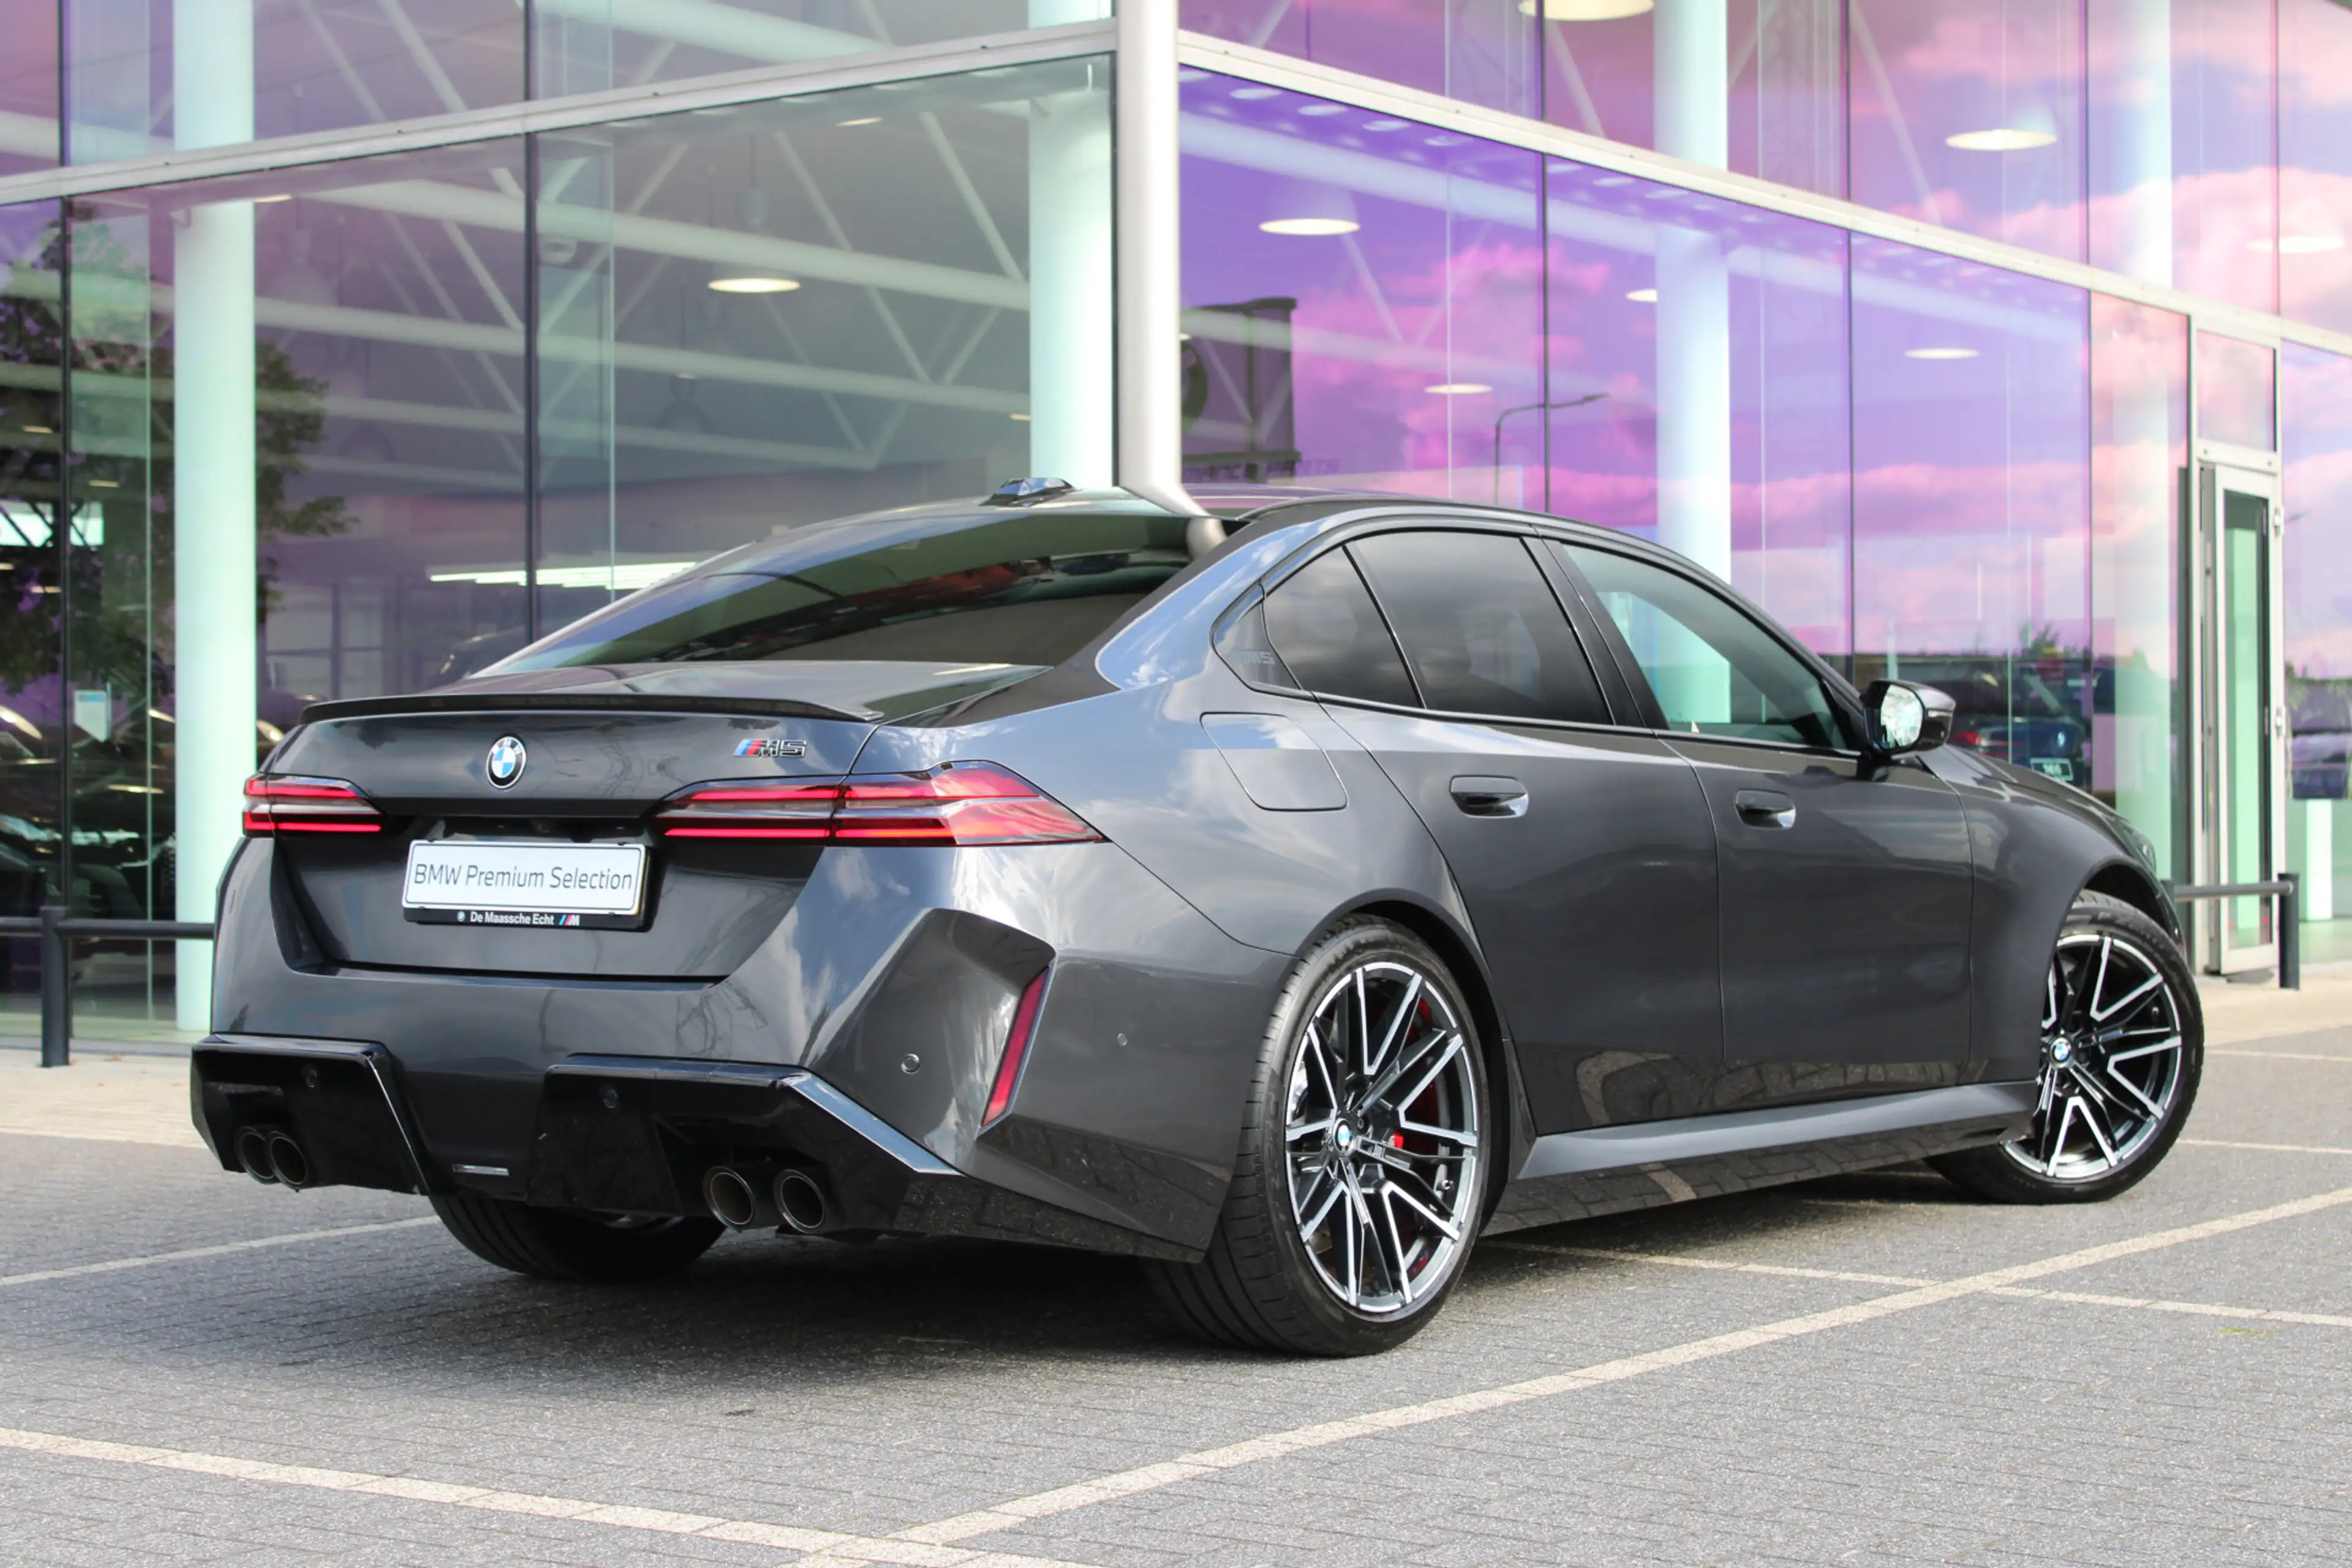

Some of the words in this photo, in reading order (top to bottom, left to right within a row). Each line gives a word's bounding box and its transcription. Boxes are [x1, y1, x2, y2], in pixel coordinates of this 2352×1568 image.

[757, 739, 807, 758] M5
[413, 863, 462, 886] BMW
[465, 864, 545, 888] Premium
[549, 865, 633, 890] Selection
[470, 911, 483, 922] De
[484, 911, 531, 925] Maassche
[532, 913, 555, 925] Echt
